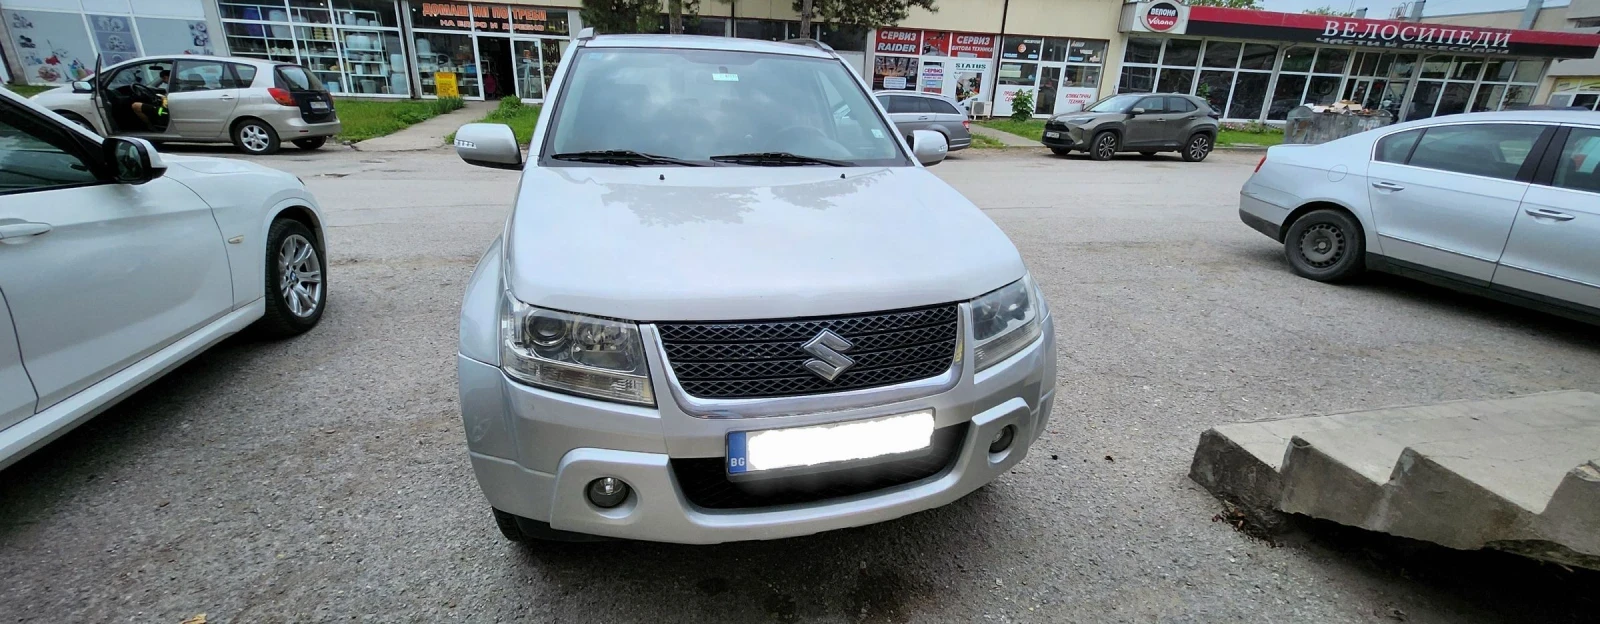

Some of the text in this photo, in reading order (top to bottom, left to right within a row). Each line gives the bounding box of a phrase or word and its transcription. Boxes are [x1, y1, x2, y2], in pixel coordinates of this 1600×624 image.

[880, 30, 917, 41] СЕРВИЗ
[1321, 20, 1512, 49] ВЕЛОСИПЕДИ
[956, 35, 991, 46] СЕРВИЗ
[1316, 37, 1380, 47] ЧАСТИ
[877, 42, 916, 53] RAIDER
[730, 457, 745, 467] BG
